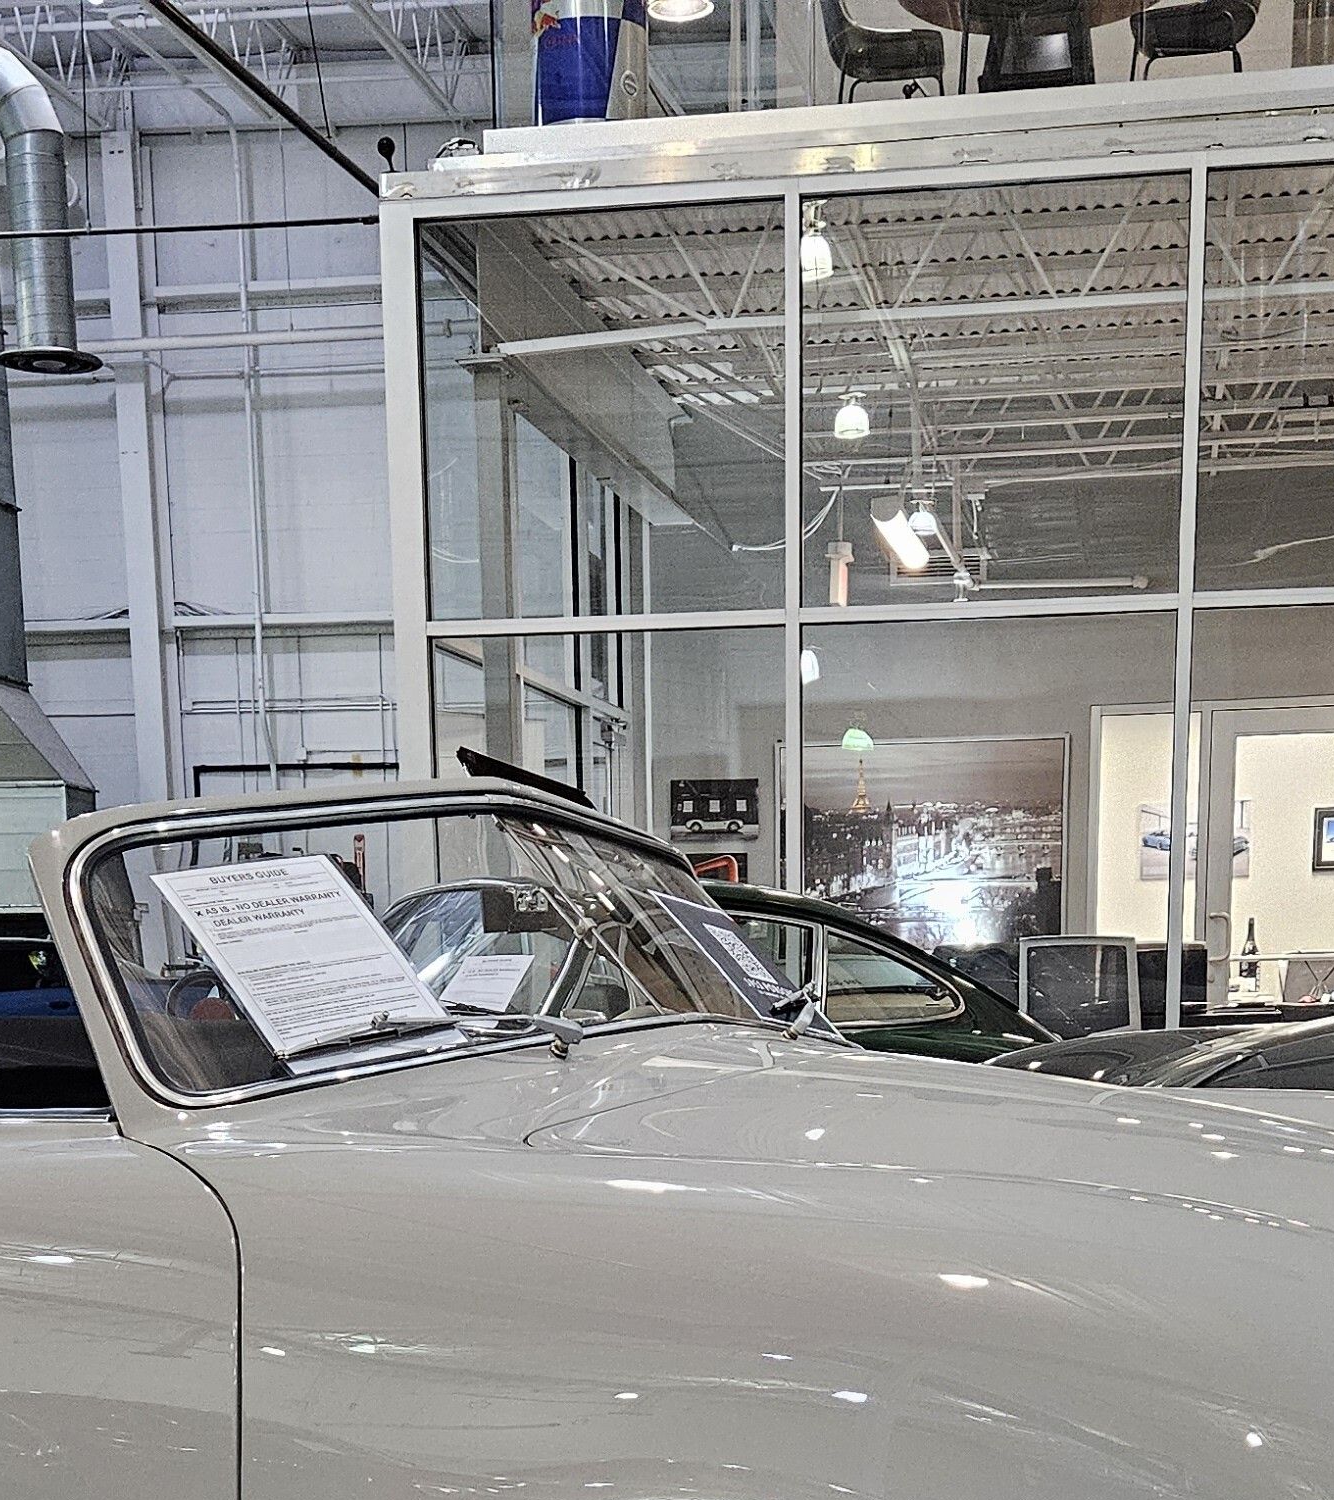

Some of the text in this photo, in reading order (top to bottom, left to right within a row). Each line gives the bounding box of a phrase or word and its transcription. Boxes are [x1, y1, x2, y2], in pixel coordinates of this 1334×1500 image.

[209, 868, 289, 884] BUYERS GUIDE
[236, 902, 252, 911] NO
[253, 897, 289, 909] DEALER
[290, 890, 342, 903] WARRANTY
[212, 915, 252, 927] DEALER
[253, 908, 306, 921] WARRANTY
